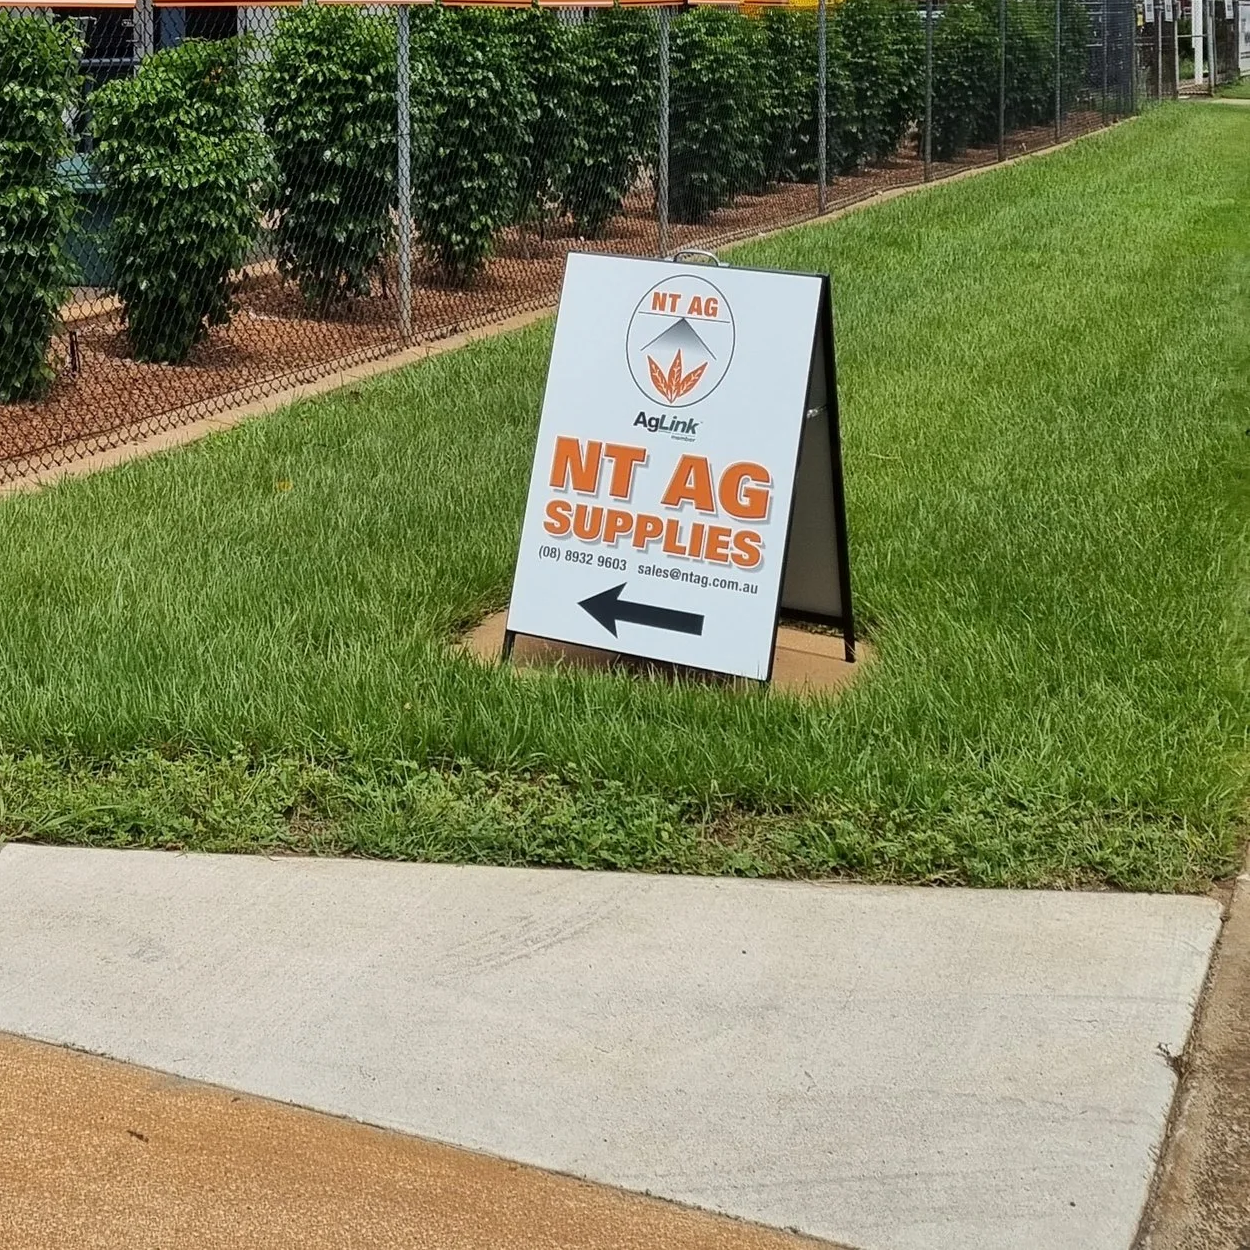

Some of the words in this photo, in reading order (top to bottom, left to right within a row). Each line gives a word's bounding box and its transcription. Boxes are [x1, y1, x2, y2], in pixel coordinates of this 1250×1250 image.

[651, 291, 682, 315] NT
[687, 295, 719, 318] AG
[633, 411, 700, 434] AgLink
[549, 435, 647, 500] NT
[660, 453, 772, 520] AG
[543, 500, 763, 570] SUPPLIES
[538, 544, 562, 562] (08)
[564, 547, 593, 568] 8932
[596, 552, 627, 572] 9603
[637, 561, 759, 596] sales@ntag.com.au
